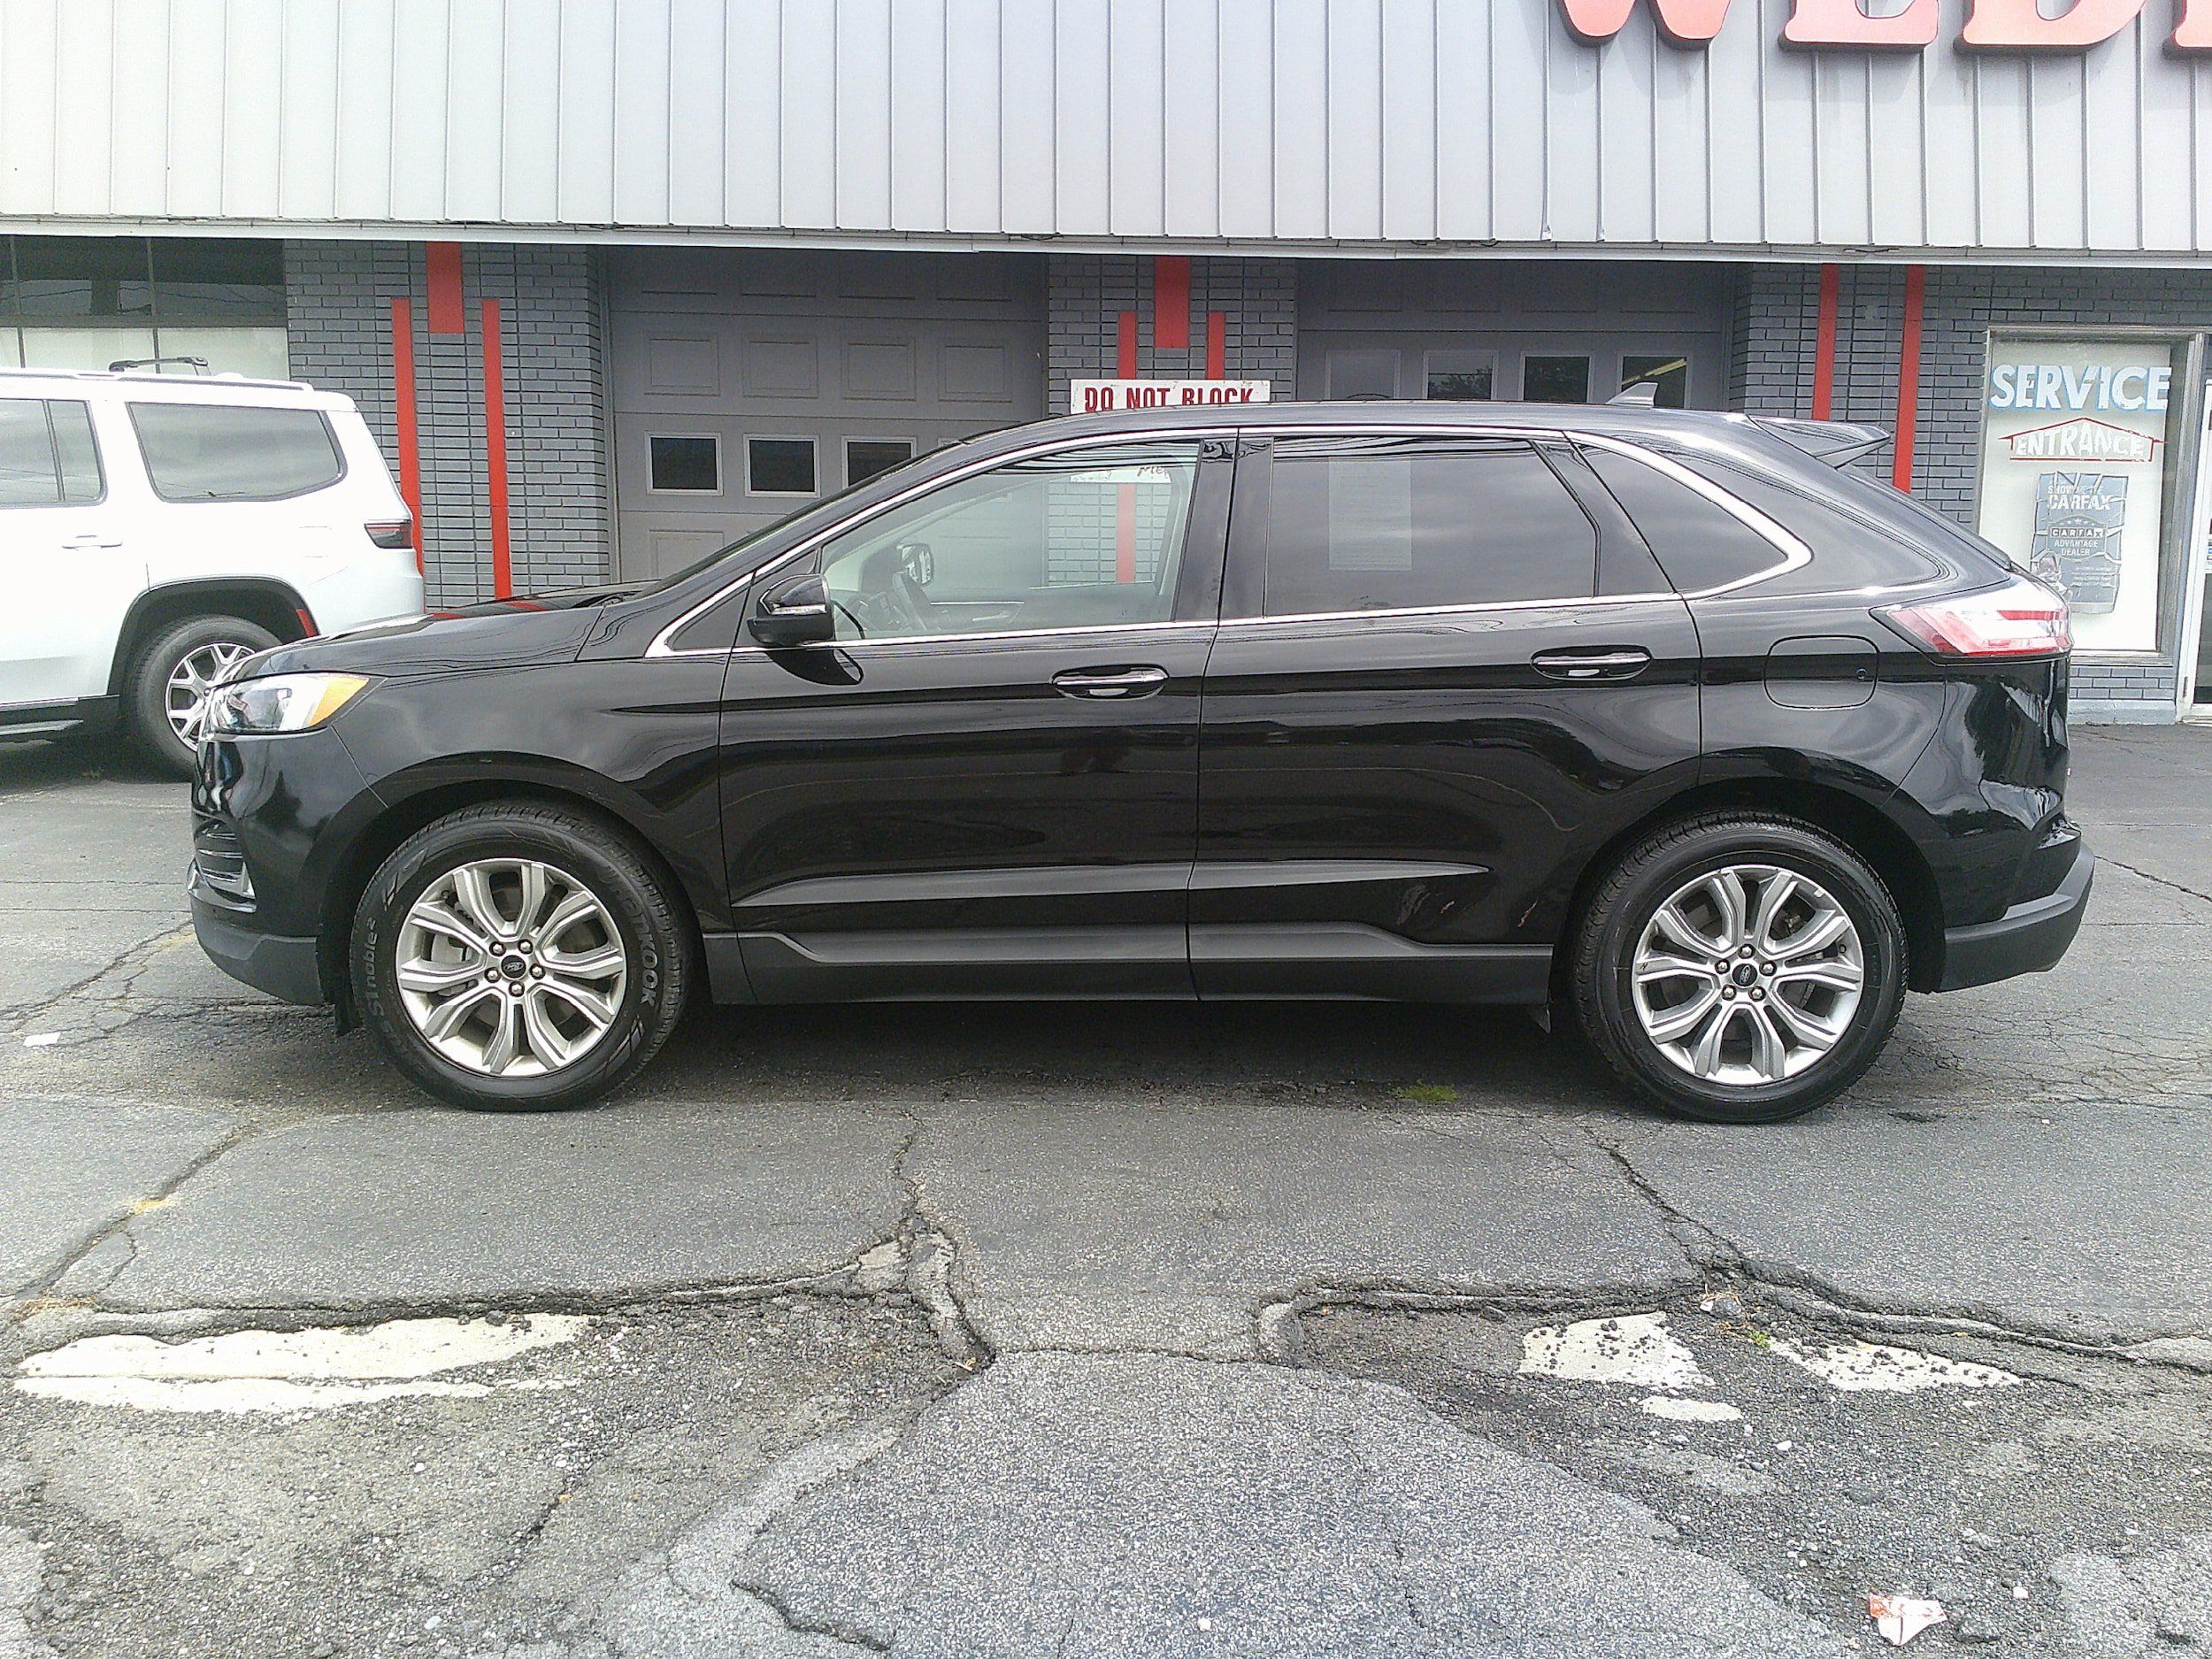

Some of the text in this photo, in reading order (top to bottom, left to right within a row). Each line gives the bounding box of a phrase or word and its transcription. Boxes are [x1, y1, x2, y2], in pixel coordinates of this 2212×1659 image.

[1990, 365, 2172, 411] SERVICE
[1084, 387, 1114, 412] DO
[1125, 388, 1171, 409] NOT
[2015, 421, 2146, 457] ENTRANCE
[2048, 495, 2111, 511] CARFAX
[2051, 527, 2104, 538] CARFAX
[2053, 539, 2100, 549] ADVANTAGE
[2061, 548, 2091, 557] DEALER
